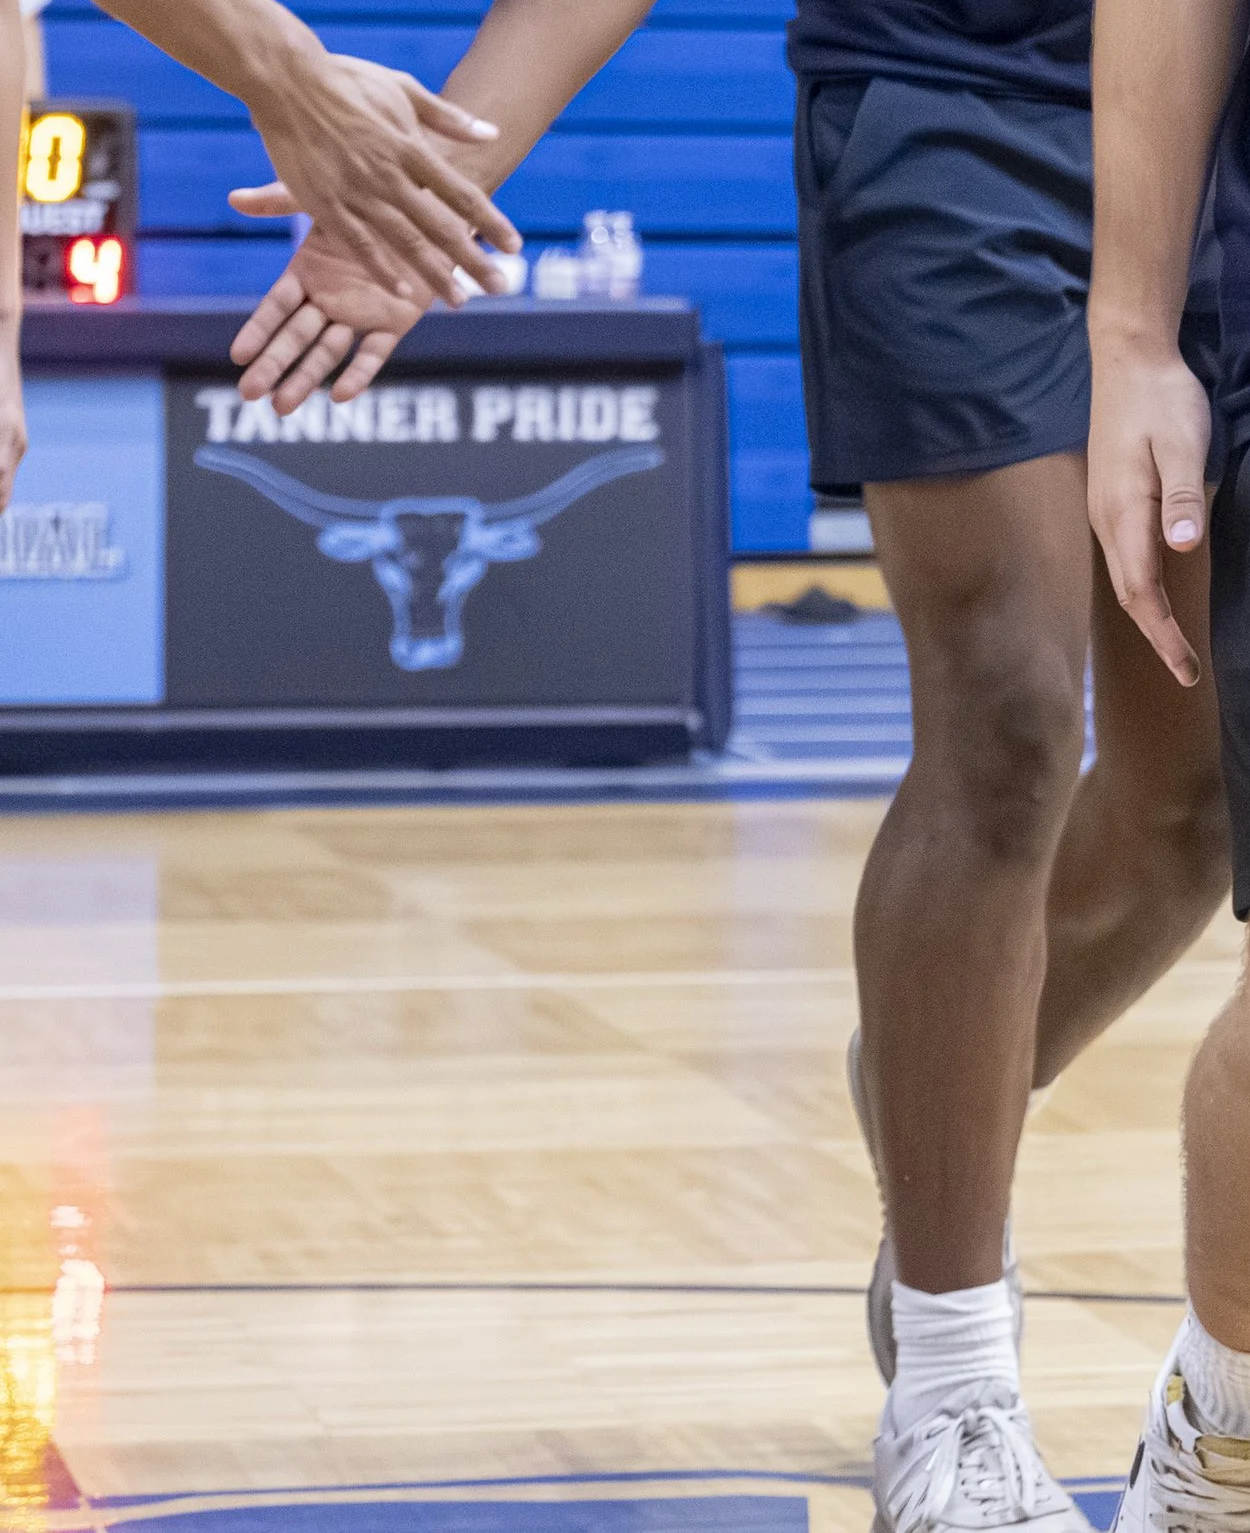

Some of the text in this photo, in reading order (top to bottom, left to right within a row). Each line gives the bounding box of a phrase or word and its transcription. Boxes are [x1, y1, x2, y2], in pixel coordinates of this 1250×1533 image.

[24, 113, 86, 201] 0
[195, 386, 660, 443] TANNER PRIDE
